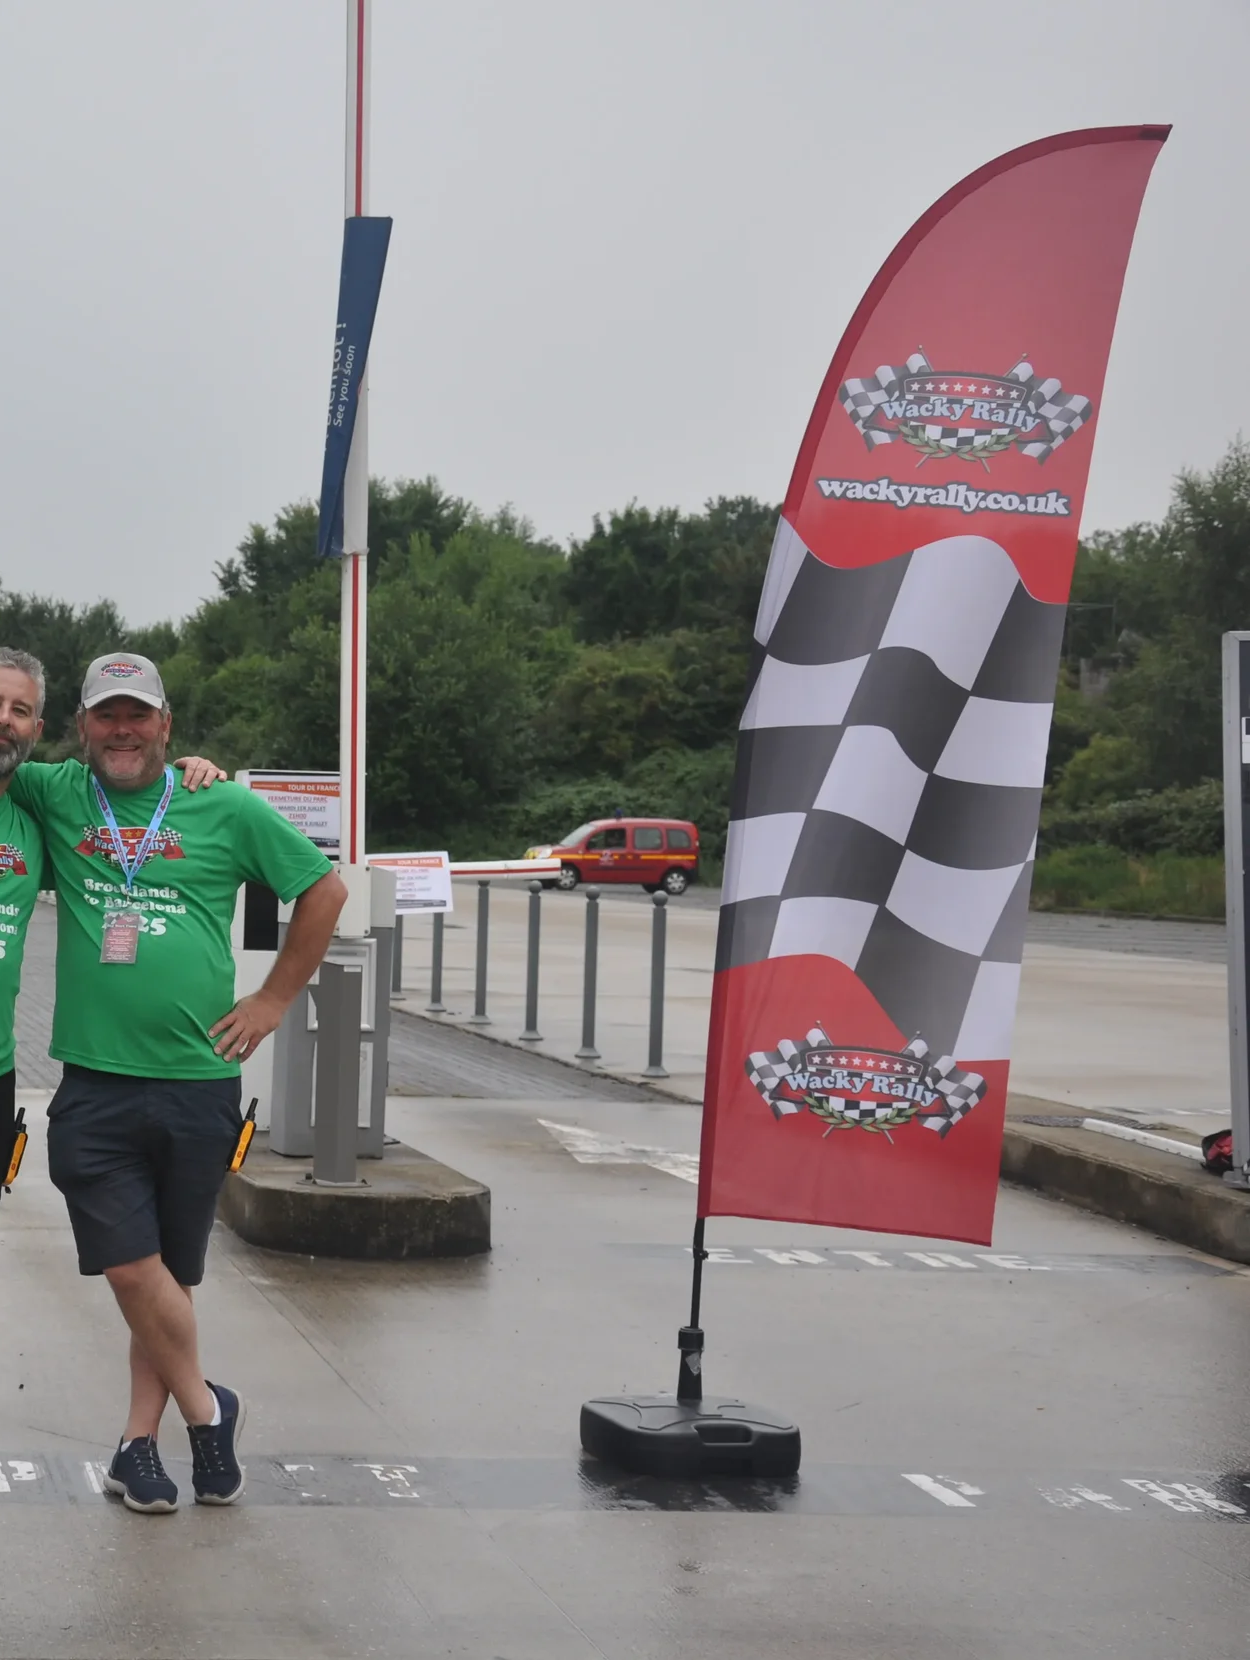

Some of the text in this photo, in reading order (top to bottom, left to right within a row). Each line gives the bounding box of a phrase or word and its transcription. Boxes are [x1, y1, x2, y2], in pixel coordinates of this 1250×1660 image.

[333, 345, 356, 426] See you soon
[881, 398, 1041, 432] Wacky Rally
[817, 478, 1070, 515] wackyrally.co.uk
[94, 837, 131, 853] Wacy
[83, 894, 99, 905] to
[786, 1072, 939, 1106] Wacky Rally
[685, 1247, 1105, 1271] ENTRE
